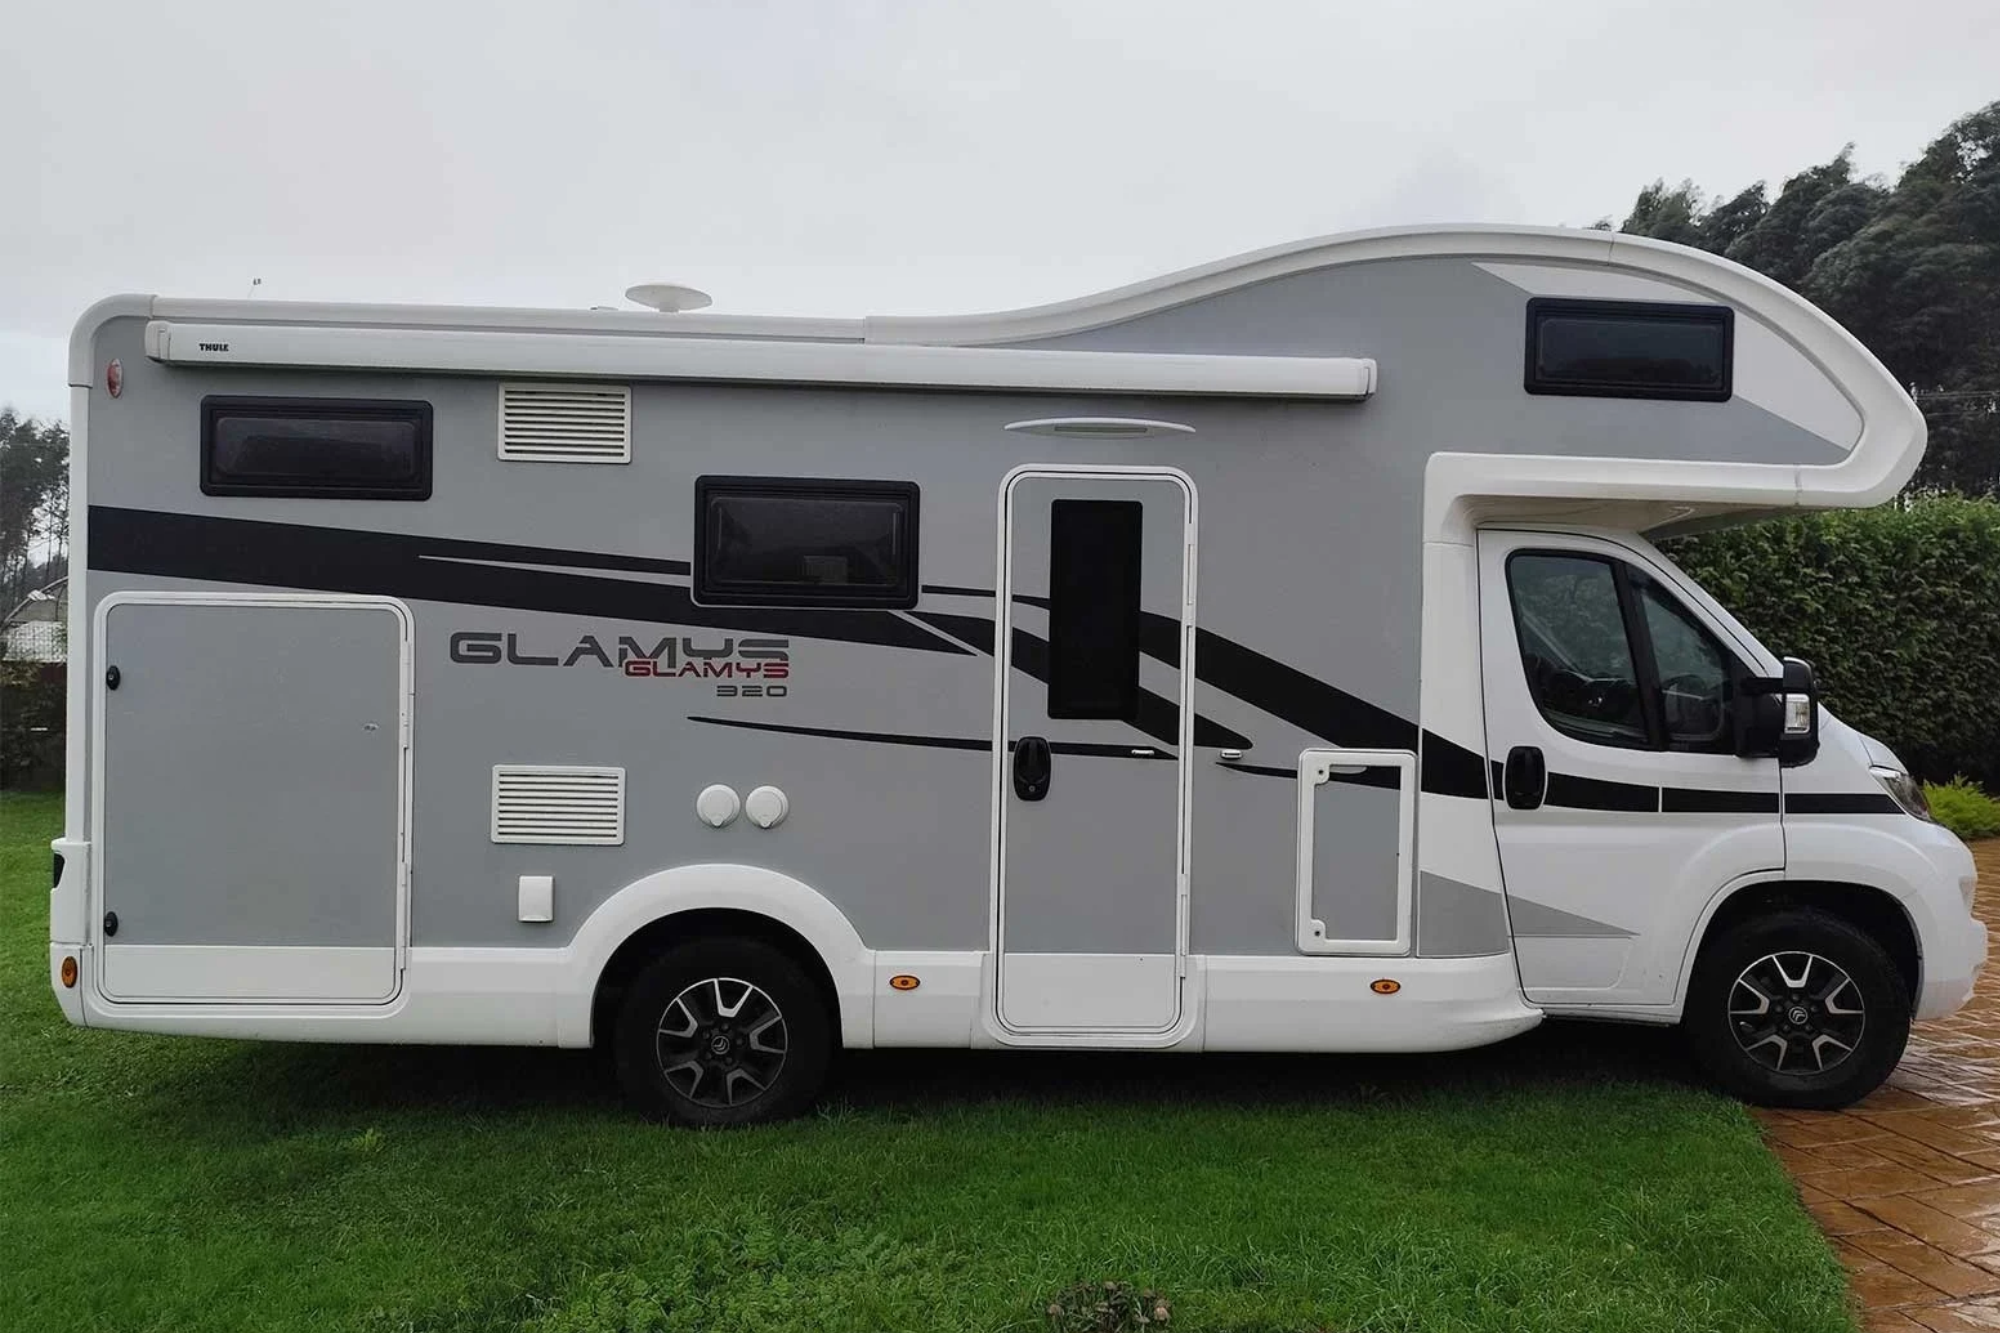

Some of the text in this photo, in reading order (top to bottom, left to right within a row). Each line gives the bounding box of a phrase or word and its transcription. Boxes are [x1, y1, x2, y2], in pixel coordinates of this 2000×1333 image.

[199, 343, 229, 351] THULE
[450, 632, 789, 669] GLAMYS
[624, 660, 789, 678] GLAMYS
[716, 685, 787, 697] 320
